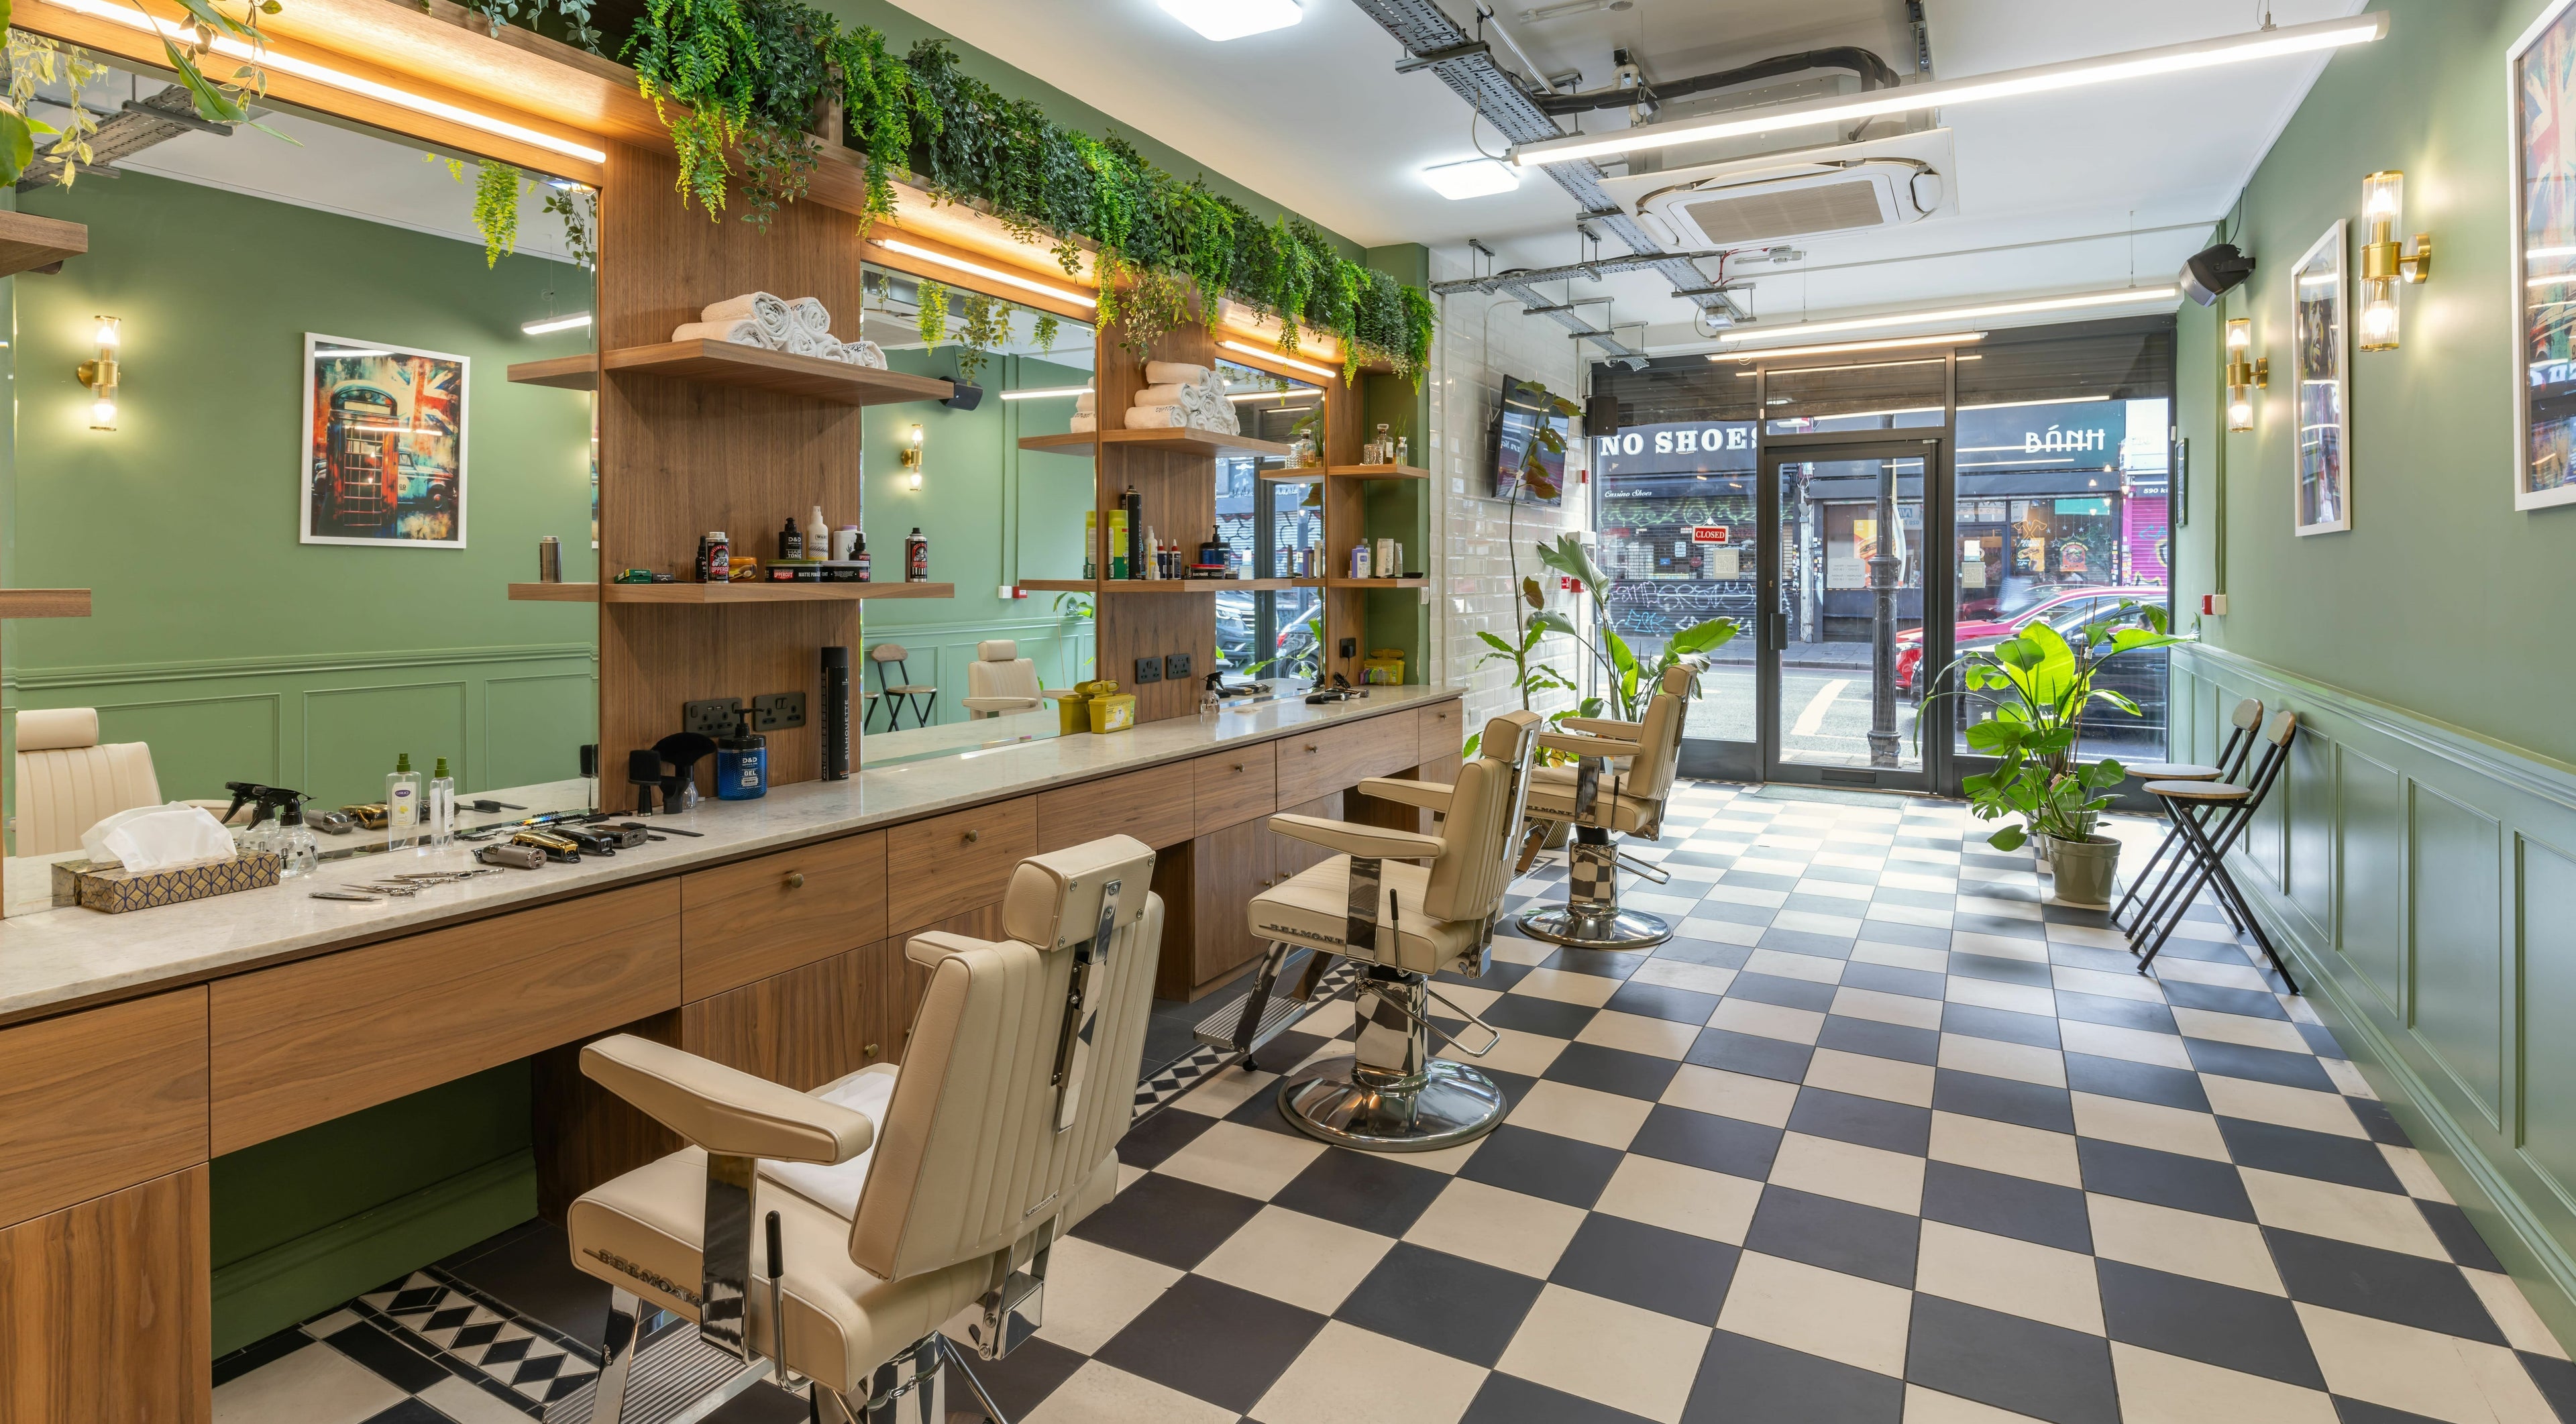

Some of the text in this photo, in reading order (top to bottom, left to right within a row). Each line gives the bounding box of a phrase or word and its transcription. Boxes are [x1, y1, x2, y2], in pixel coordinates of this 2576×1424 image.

[1600, 433, 1644, 456] NO
[2025, 425, 2106, 453] BÁNH
[1604, 489, 1652, 498] Cassino Shoes
[1695, 531, 1725, 539] CLOSED
[1525, 805, 1572, 816] ELMONT
[1270, 924, 1344, 945] BELMONT
